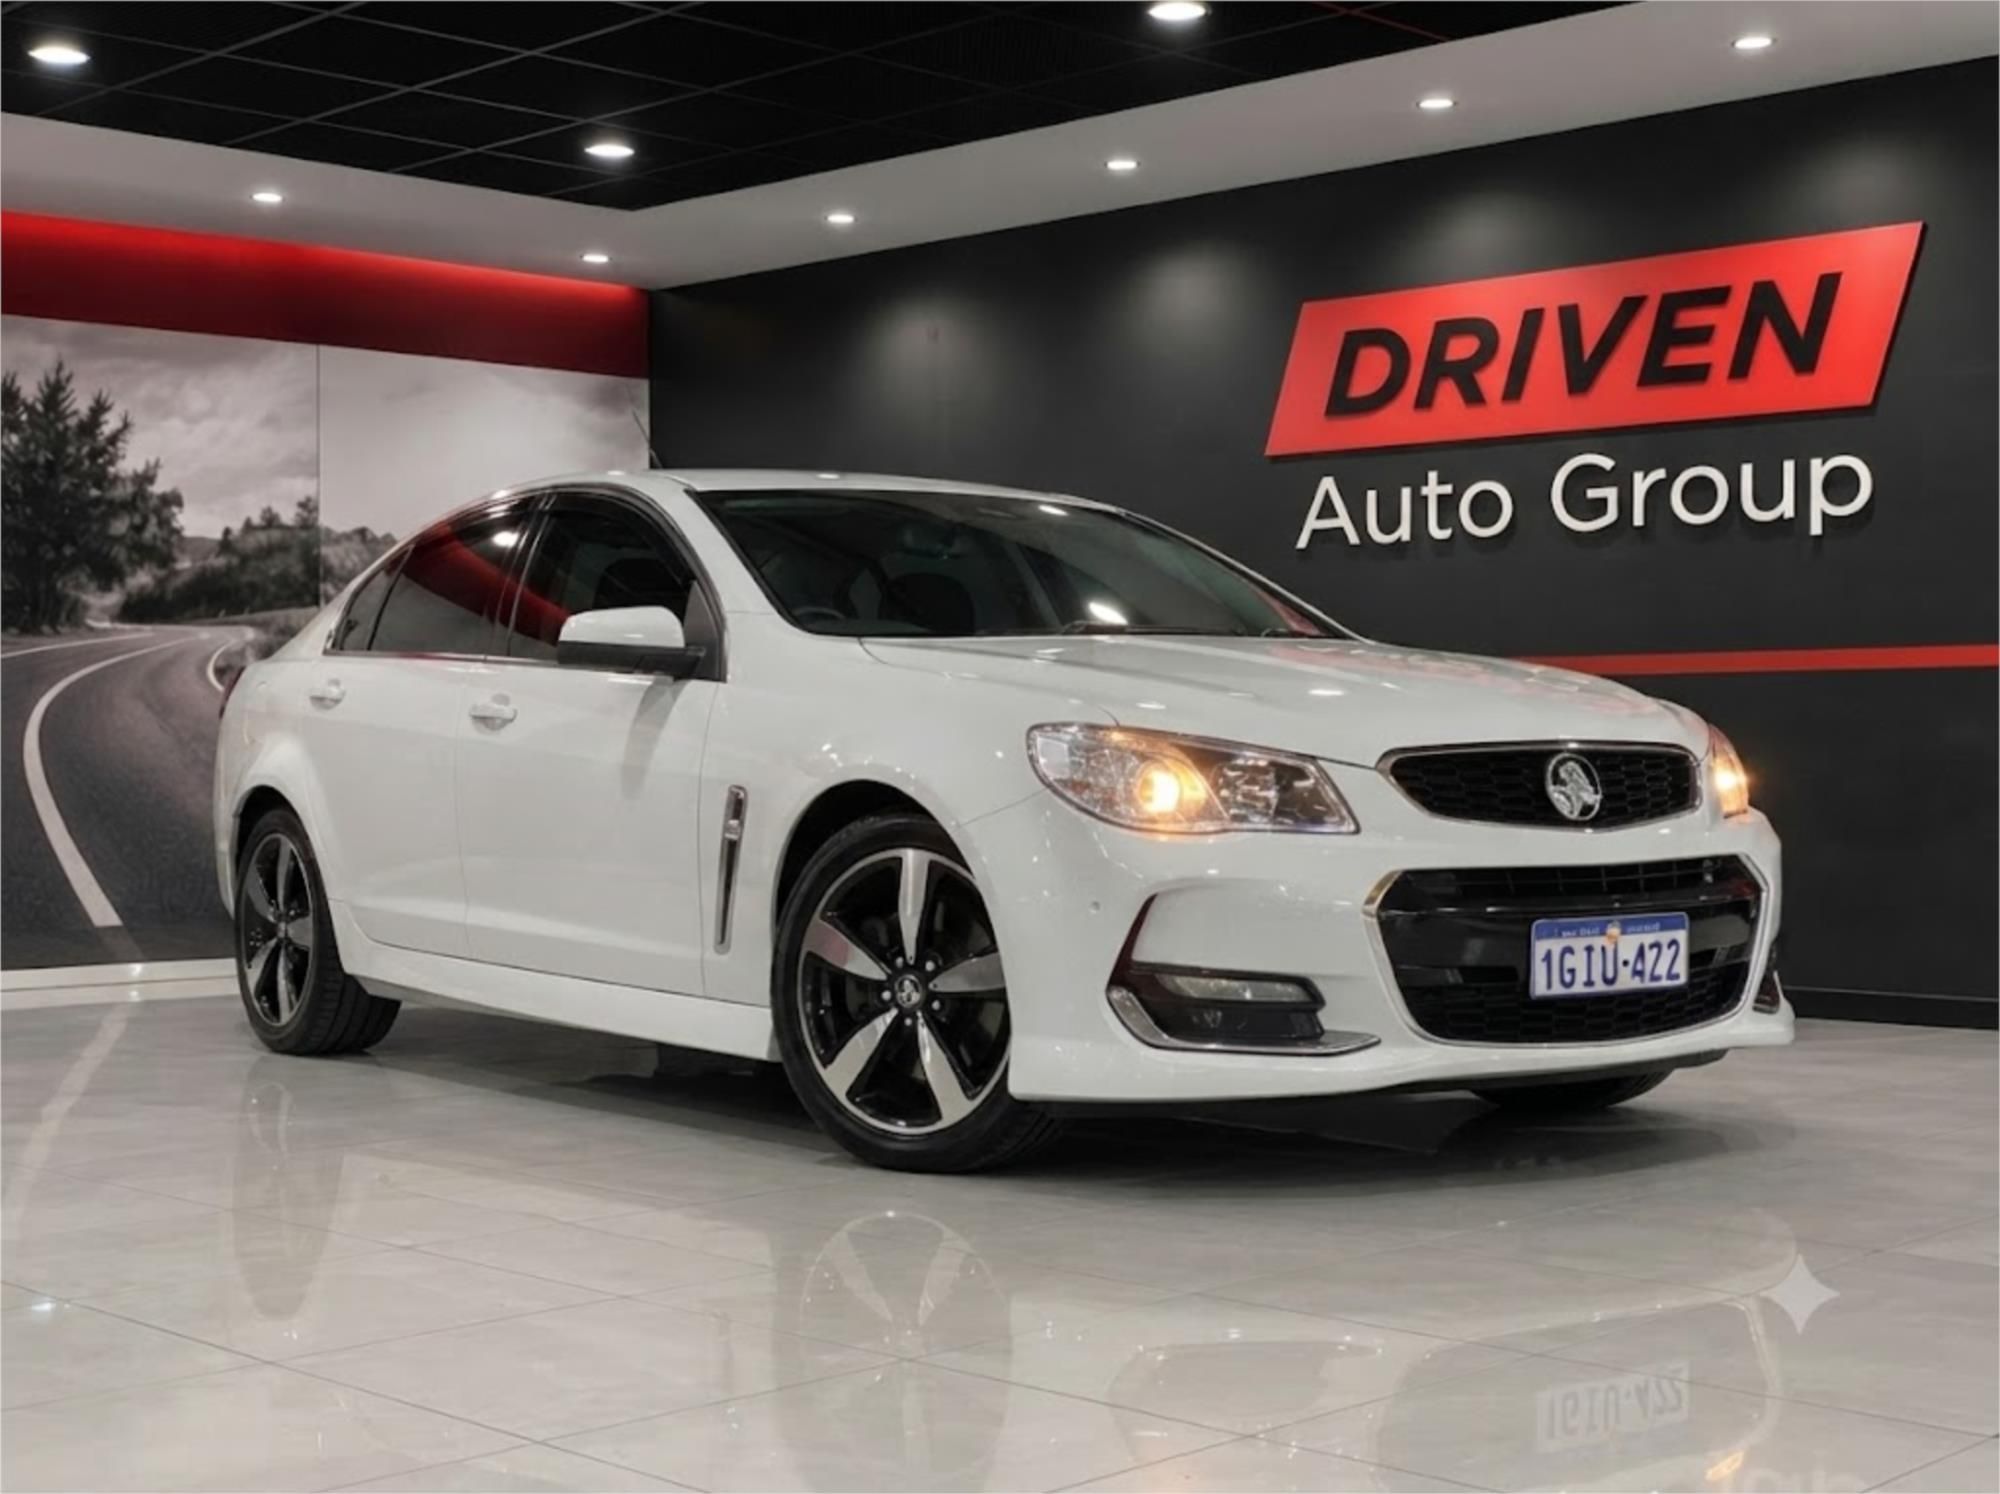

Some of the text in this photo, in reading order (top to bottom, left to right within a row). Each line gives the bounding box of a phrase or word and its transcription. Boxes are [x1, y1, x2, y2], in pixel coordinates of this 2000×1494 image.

[1324, 272, 1843, 417] DRIVEN
[1296, 452, 1874, 550] Auto Group
